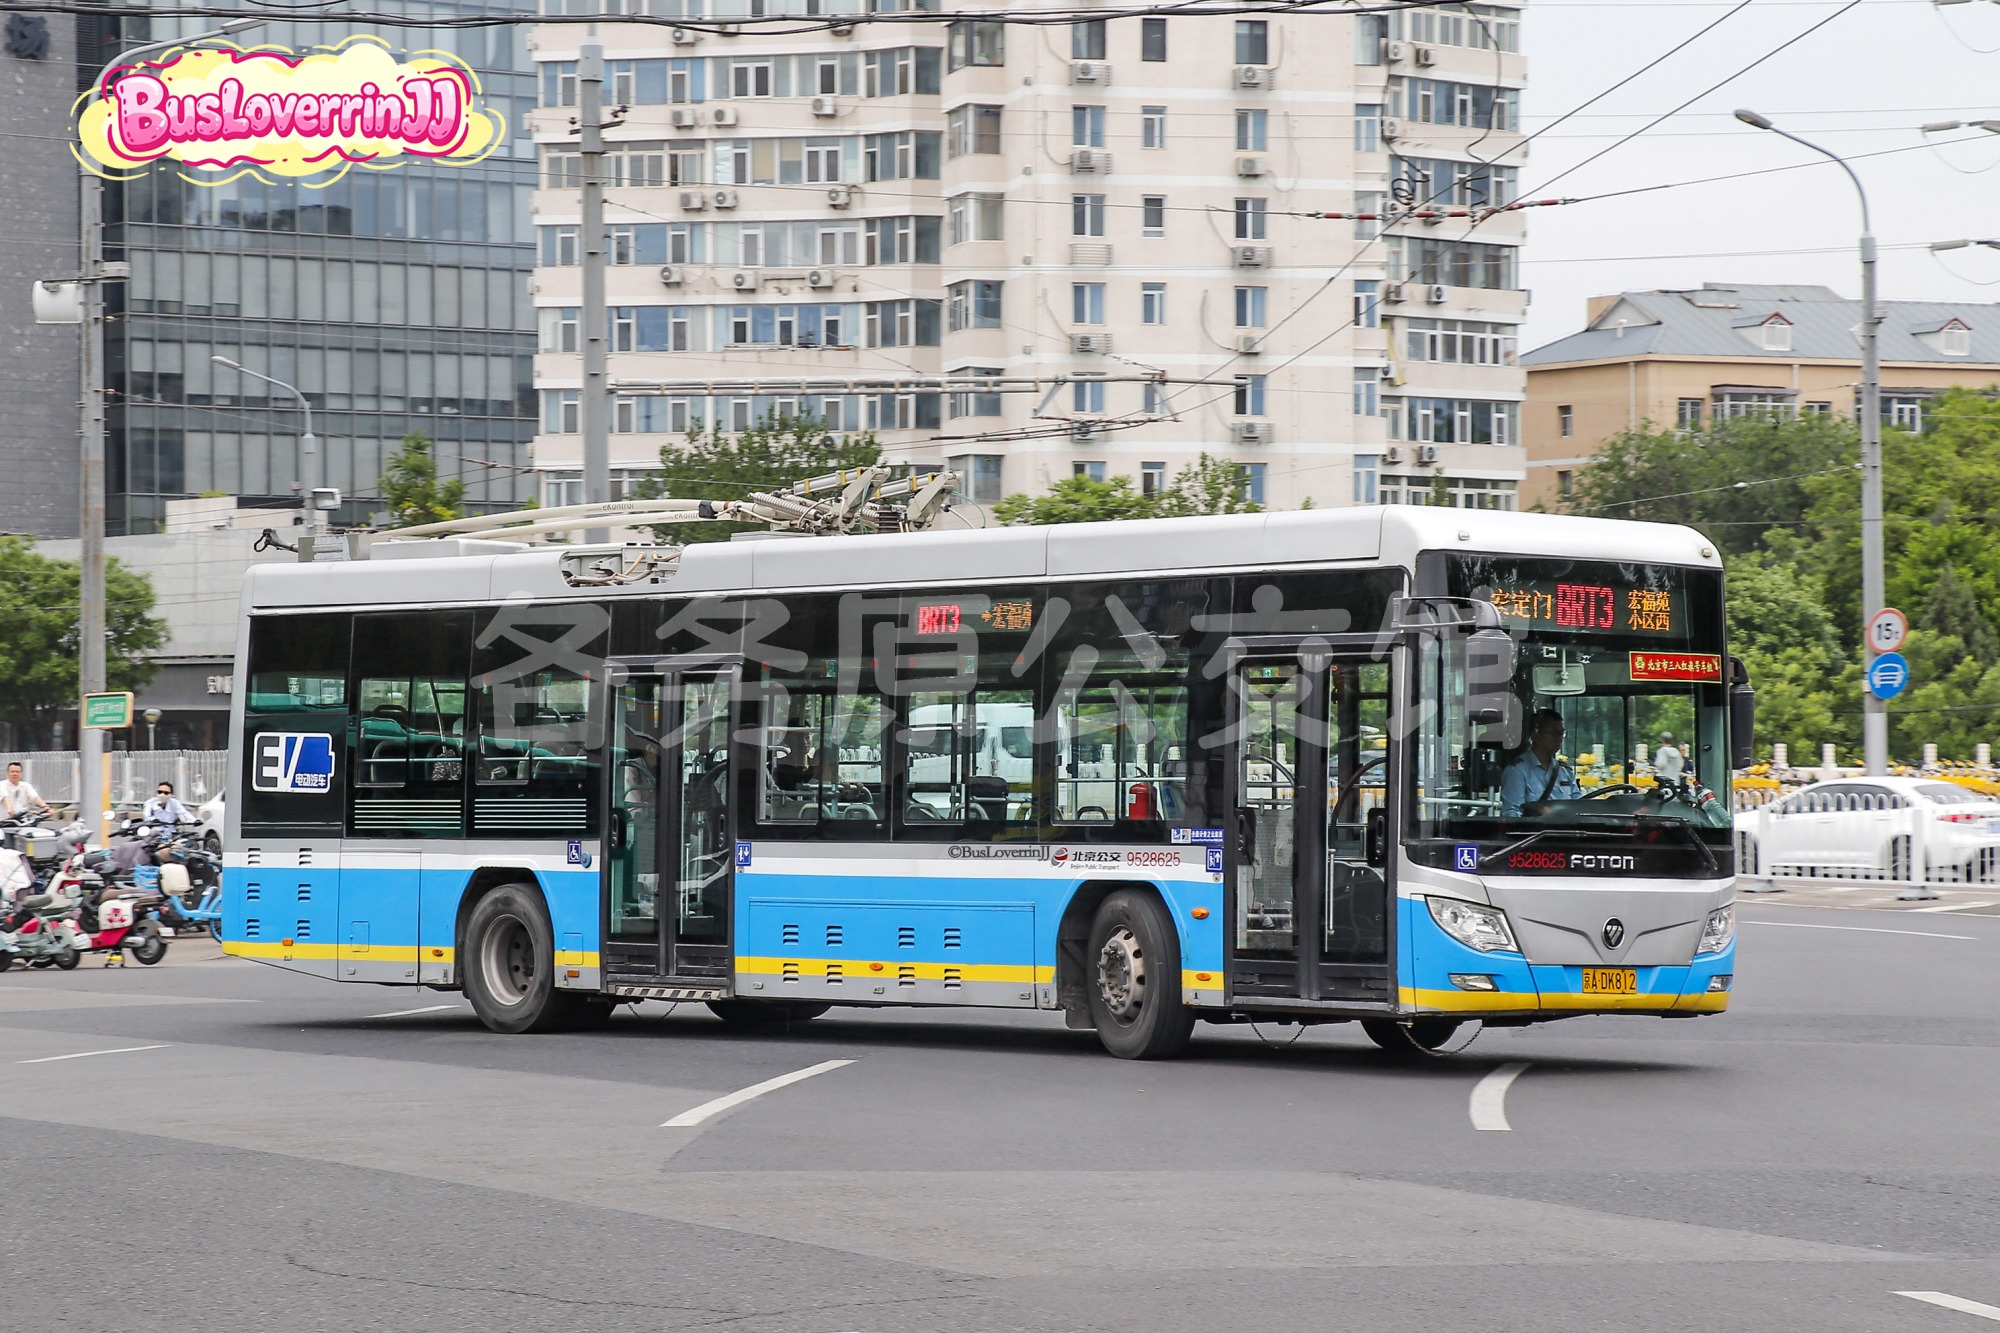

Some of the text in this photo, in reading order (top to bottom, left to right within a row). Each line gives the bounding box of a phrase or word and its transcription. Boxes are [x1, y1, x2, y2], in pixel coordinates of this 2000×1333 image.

[1556, 584, 1614, 628] BRT3
[1628, 590, 1671, 611] 宏福苑
[918, 605, 961, 634] BRT3
[1628, 610, 1671, 631] 小区西
[295, 773, 327, 787] 电动汽车
[1072, 851, 1122, 862] 北京公交
[1126, 852, 1181, 867] 9528625
[1508, 851, 1567, 869] 9528625
[1570, 854, 1634, 870] FOTON
